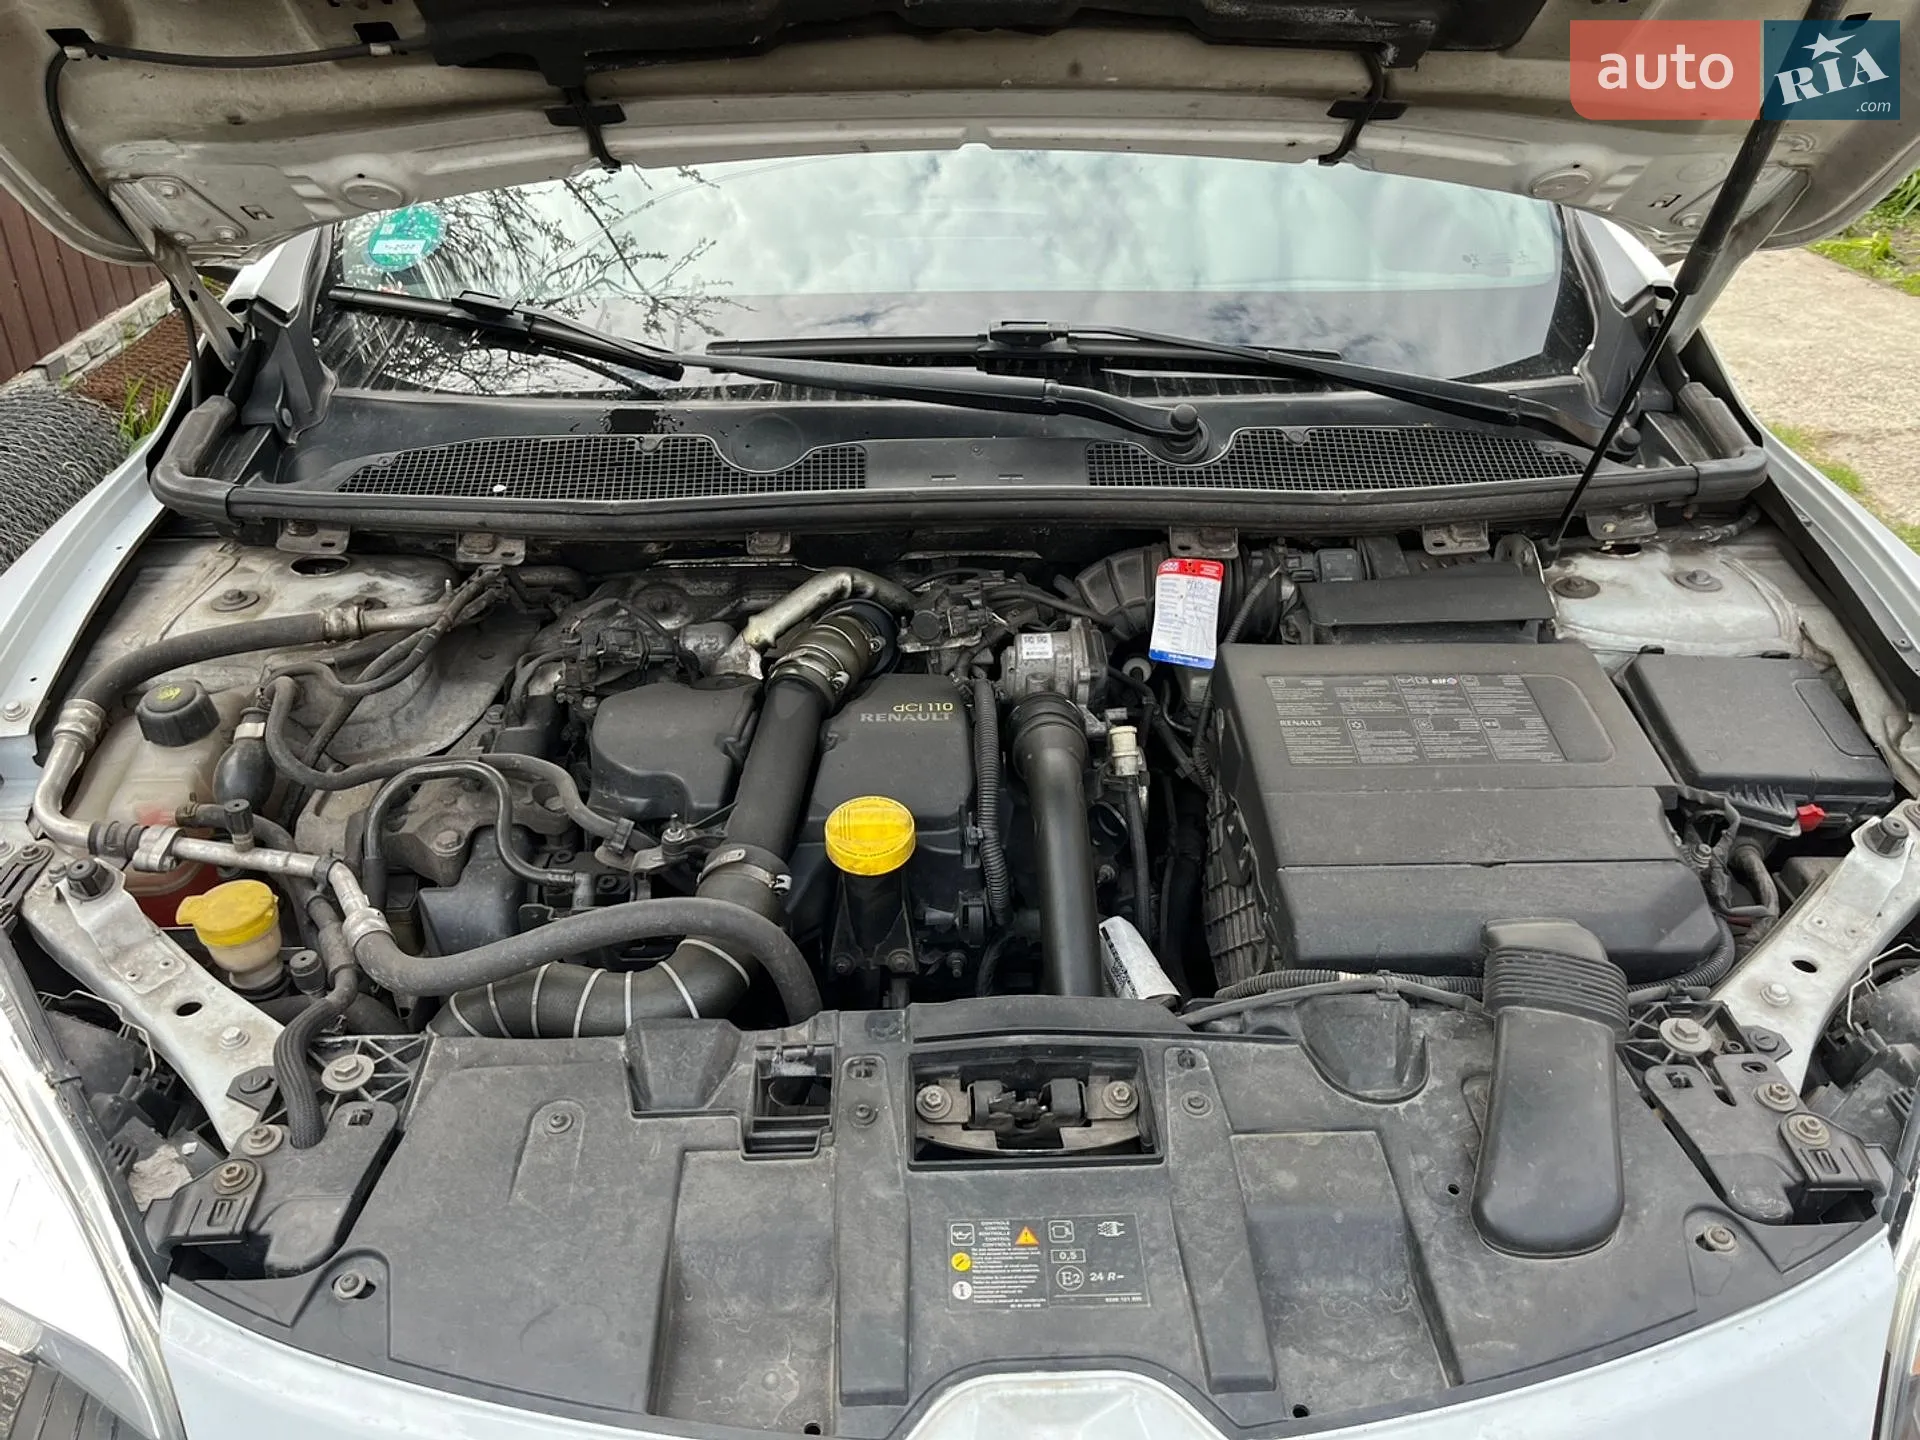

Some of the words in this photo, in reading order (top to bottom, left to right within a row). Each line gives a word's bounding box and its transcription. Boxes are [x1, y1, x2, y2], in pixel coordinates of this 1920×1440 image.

[893, 702, 922, 712] dCi
[928, 702, 954, 711] 110
[860, 712, 953, 722] RENAULT
[1279, 719, 1323, 727] RENAULT
[1059, 1251, 1078, 1261] 0,5
[1062, 1271, 1081, 1286] E2
[1089, 1272, 1104, 1281] 24
